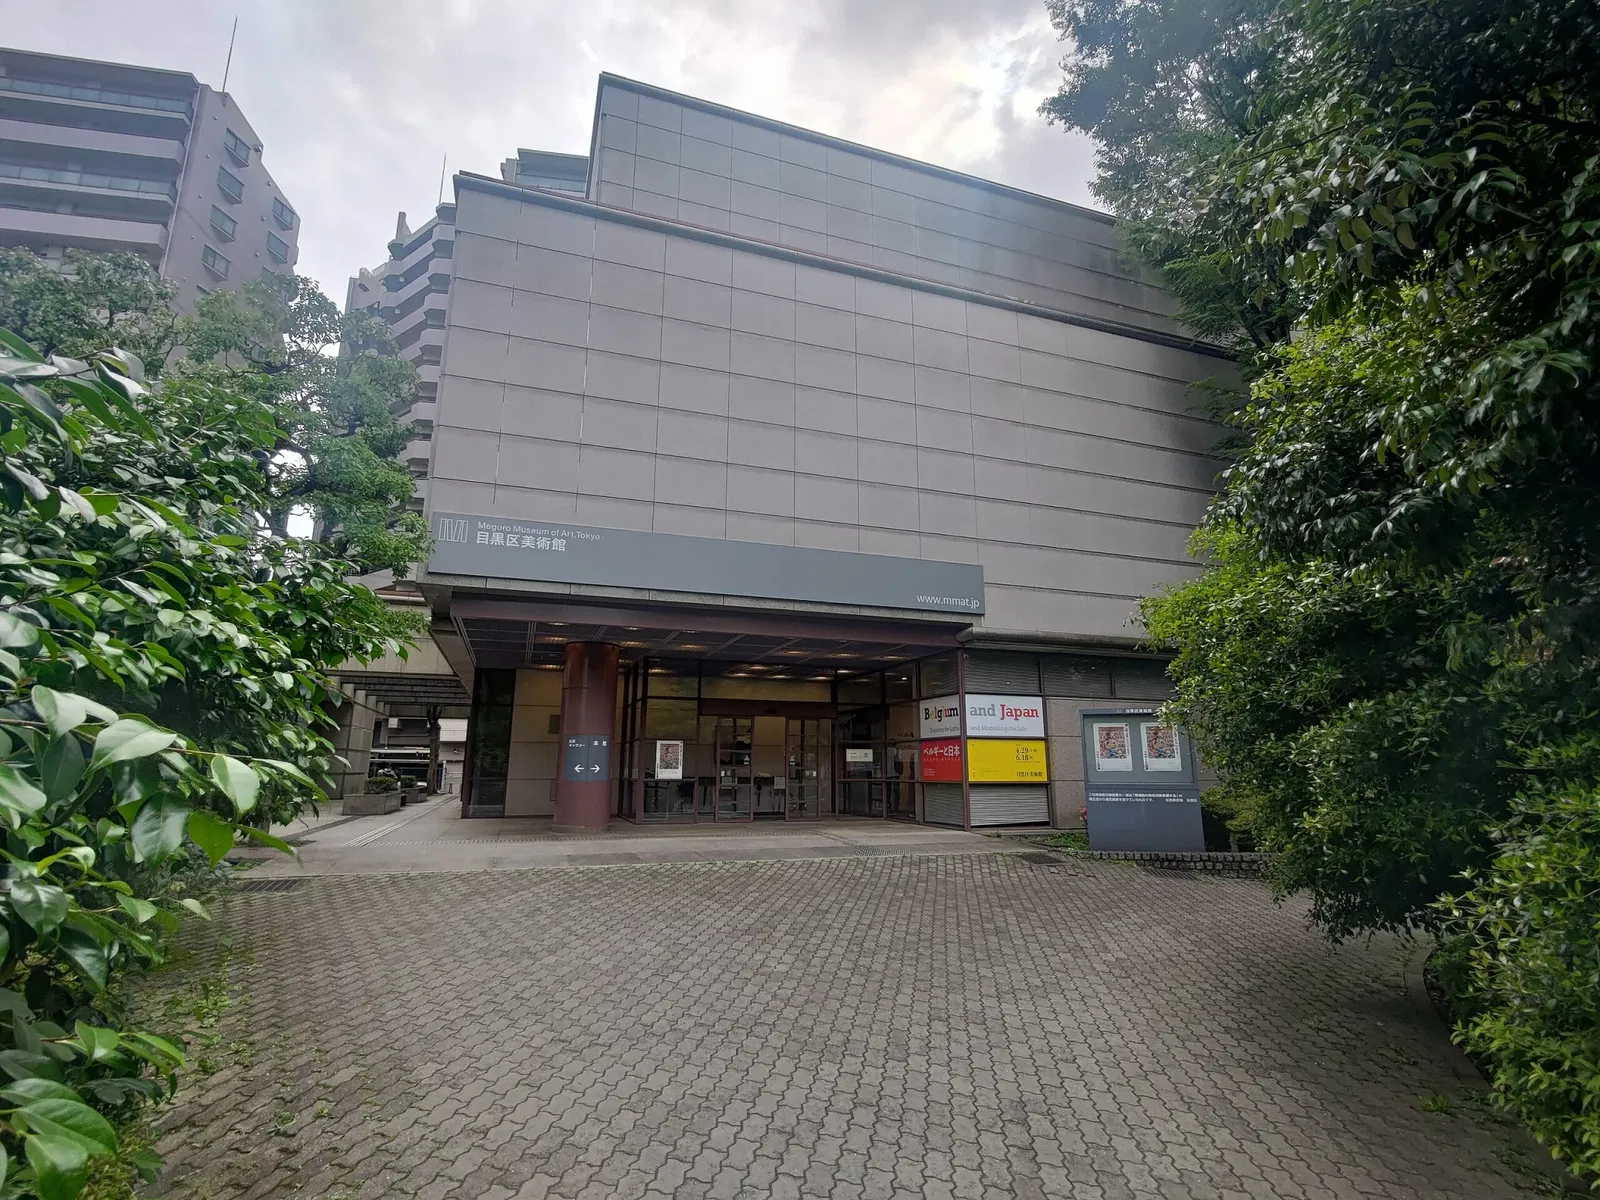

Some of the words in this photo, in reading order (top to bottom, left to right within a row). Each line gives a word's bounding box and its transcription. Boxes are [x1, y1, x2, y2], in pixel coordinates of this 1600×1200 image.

[477, 521, 511, 532] Meguro
[513, 525, 549, 535] Museum
[551, 529, 559, 537] of
[476, 531, 566, 552] 目黒区美術館
[916, 594, 980, 609] www.mmat.jp
[924, 706, 959, 722] Belgium
[969, 703, 996, 717] and
[1000, 704, 1040, 721] Japan
[923, 744, 960, 757] ベルギーと日本
